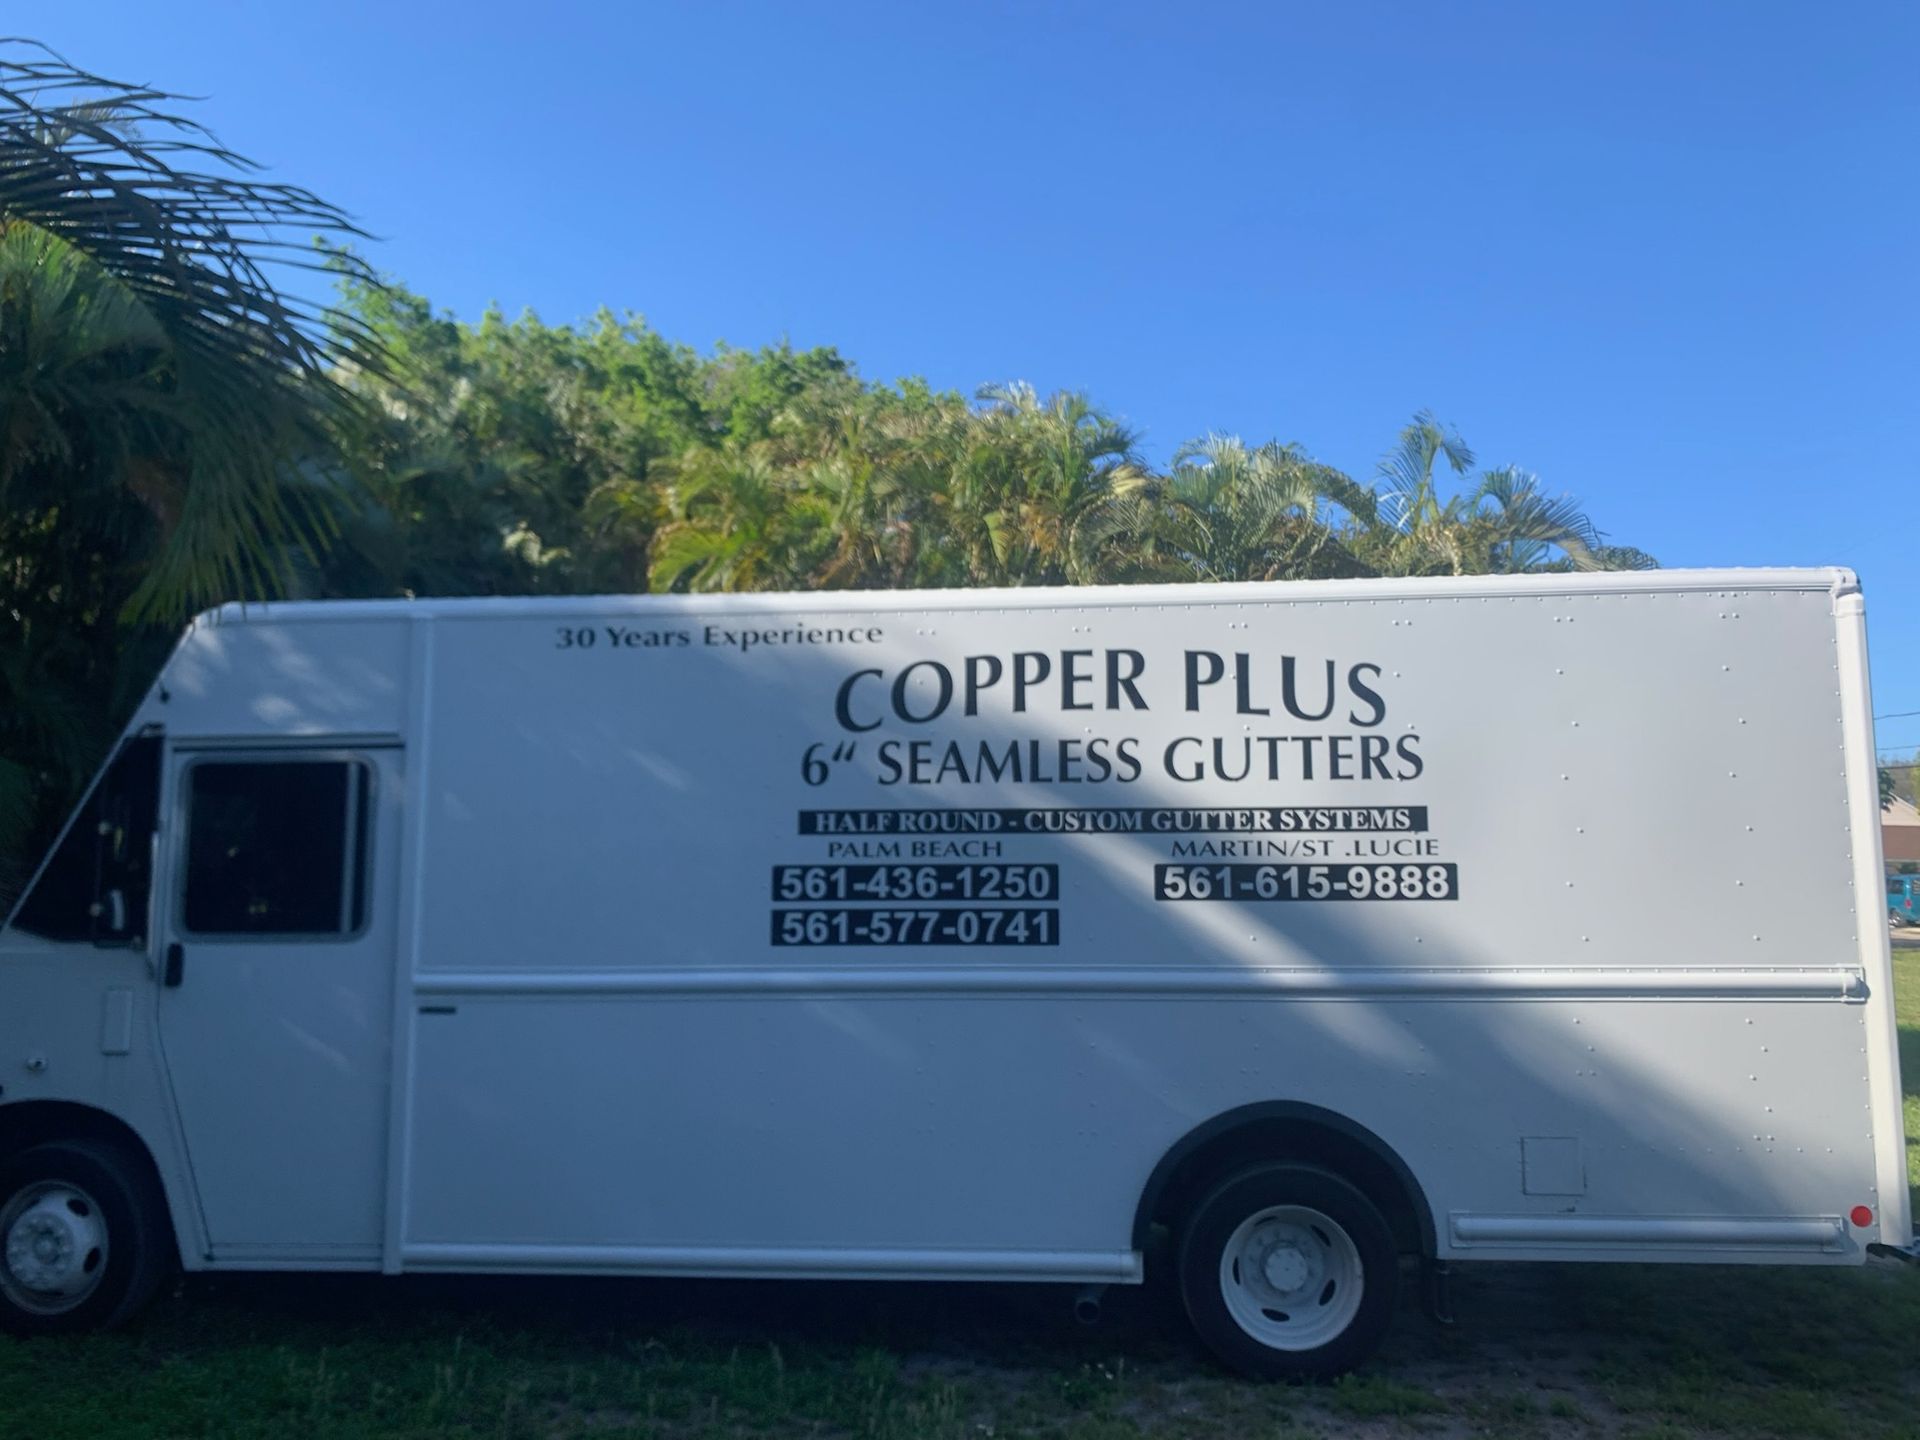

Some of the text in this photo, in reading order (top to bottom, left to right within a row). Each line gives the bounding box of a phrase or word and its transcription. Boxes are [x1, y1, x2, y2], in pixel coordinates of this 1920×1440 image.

[555, 622, 884, 652] 30 Years Experience
[835, 649, 1386, 733] COPPER PLUS
[878, 737, 1141, 785] SEAMLESS
[1163, 734, 1424, 782] GUTTERS
[815, 812, 893, 833] HALF
[899, 811, 1001, 832] ROUND
[1024, 810, 1143, 831] CUSTOM
[1151, 809, 1273, 831] GUTTER
[1280, 808, 1411, 830] SYSTEMS
[828, 841, 1002, 858] PALM BEACH
[1171, 839, 1334, 857] MARTIN/ST
[780, 867, 1050, 899] 561-436-1250
[1163, 865, 1450, 899] 561-615-9888
[781, 911, 1050, 944] 561-577-0741
